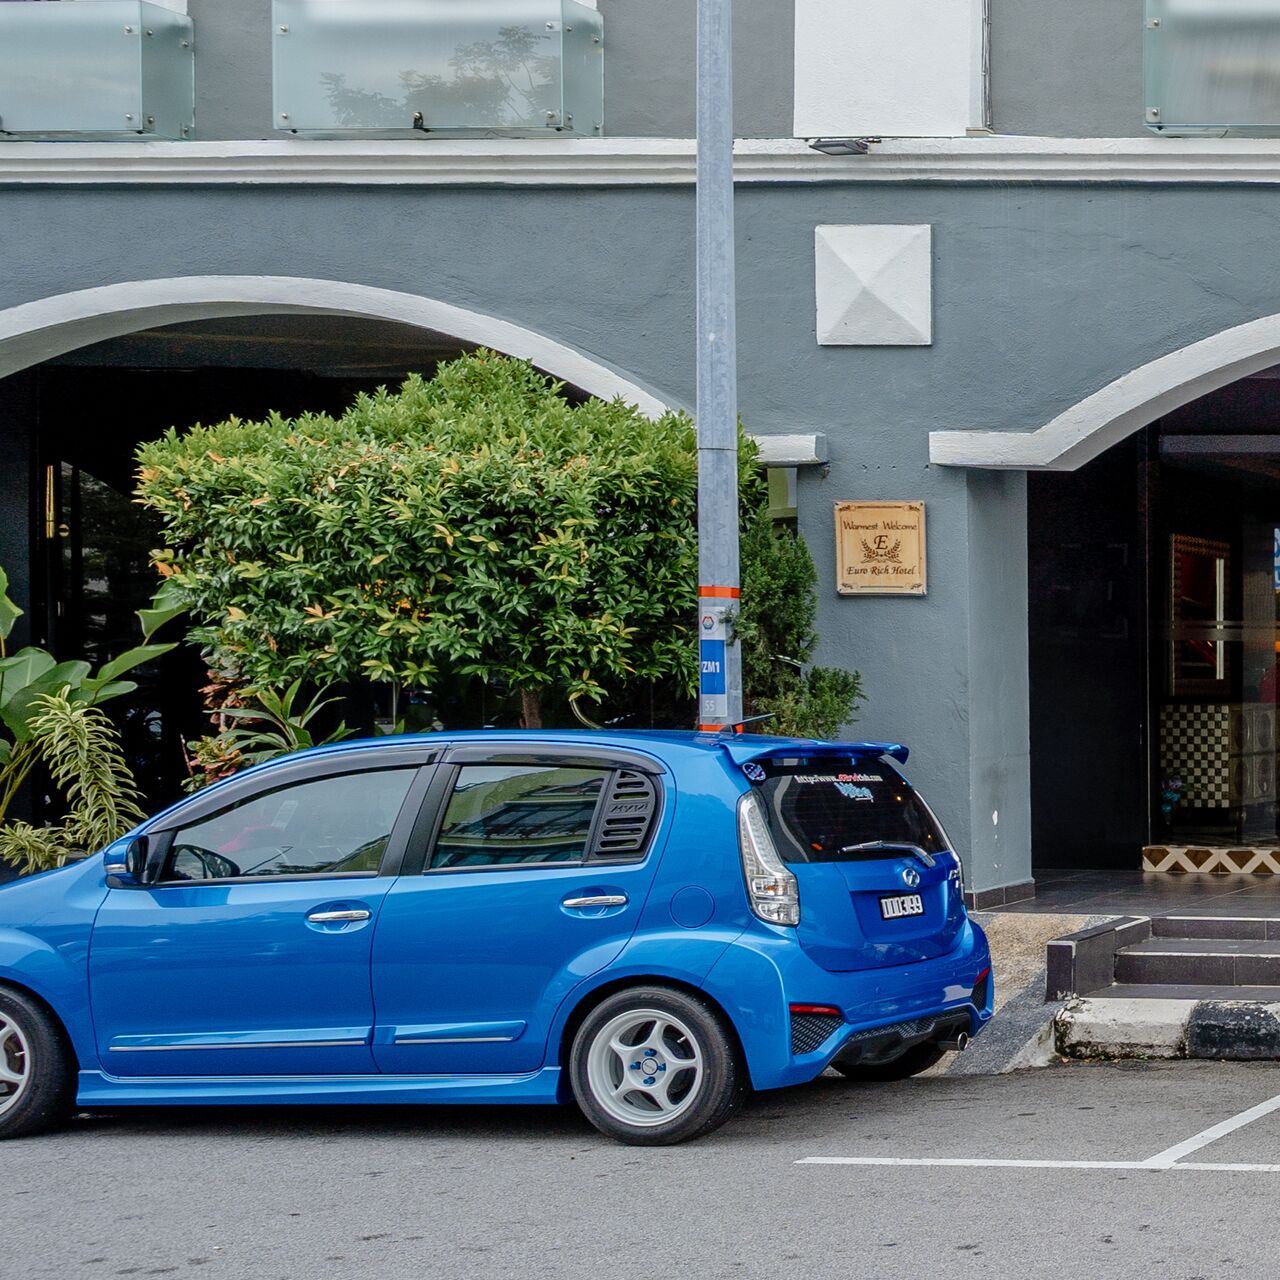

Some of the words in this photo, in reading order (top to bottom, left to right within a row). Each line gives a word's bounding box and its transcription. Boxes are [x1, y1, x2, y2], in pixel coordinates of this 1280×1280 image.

[843, 520, 878, 530] Warmest
[882, 520, 917, 530] Welcome
[873, 534, 889, 550] E
[846, 566, 868, 575] Euro
[870, 565, 889, 576] Rich
[890, 565, 917, 575] Hotel
